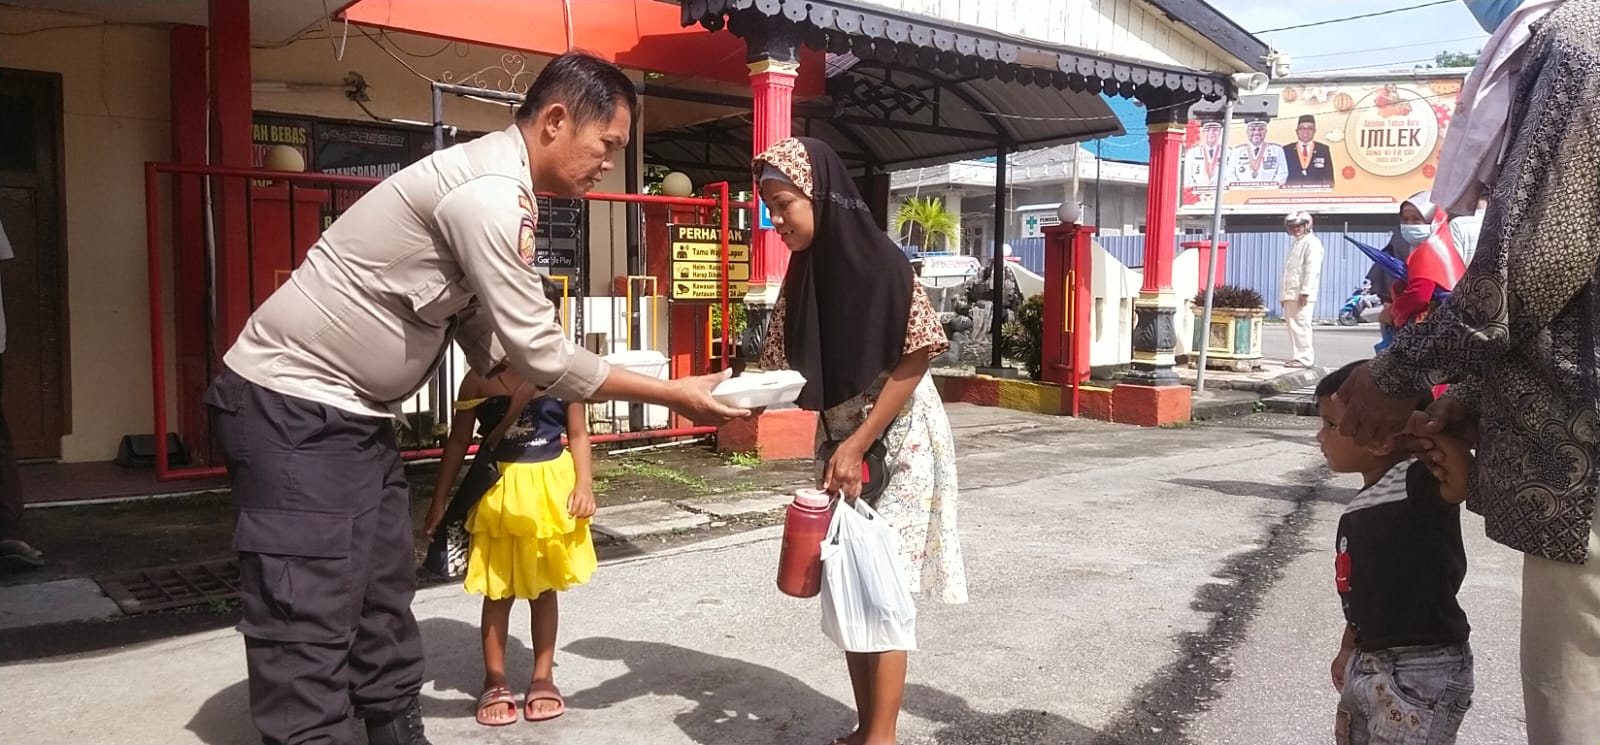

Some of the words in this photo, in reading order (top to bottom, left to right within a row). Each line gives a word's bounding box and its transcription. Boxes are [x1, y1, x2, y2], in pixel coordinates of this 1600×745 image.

[271, 126, 306, 144] BEBAS
[1360, 129, 1421, 149] IMLEK
[679, 228, 742, 241] PERHATAN
[692, 248, 709, 256] Tamu
[560, 256, 573, 267] Play
